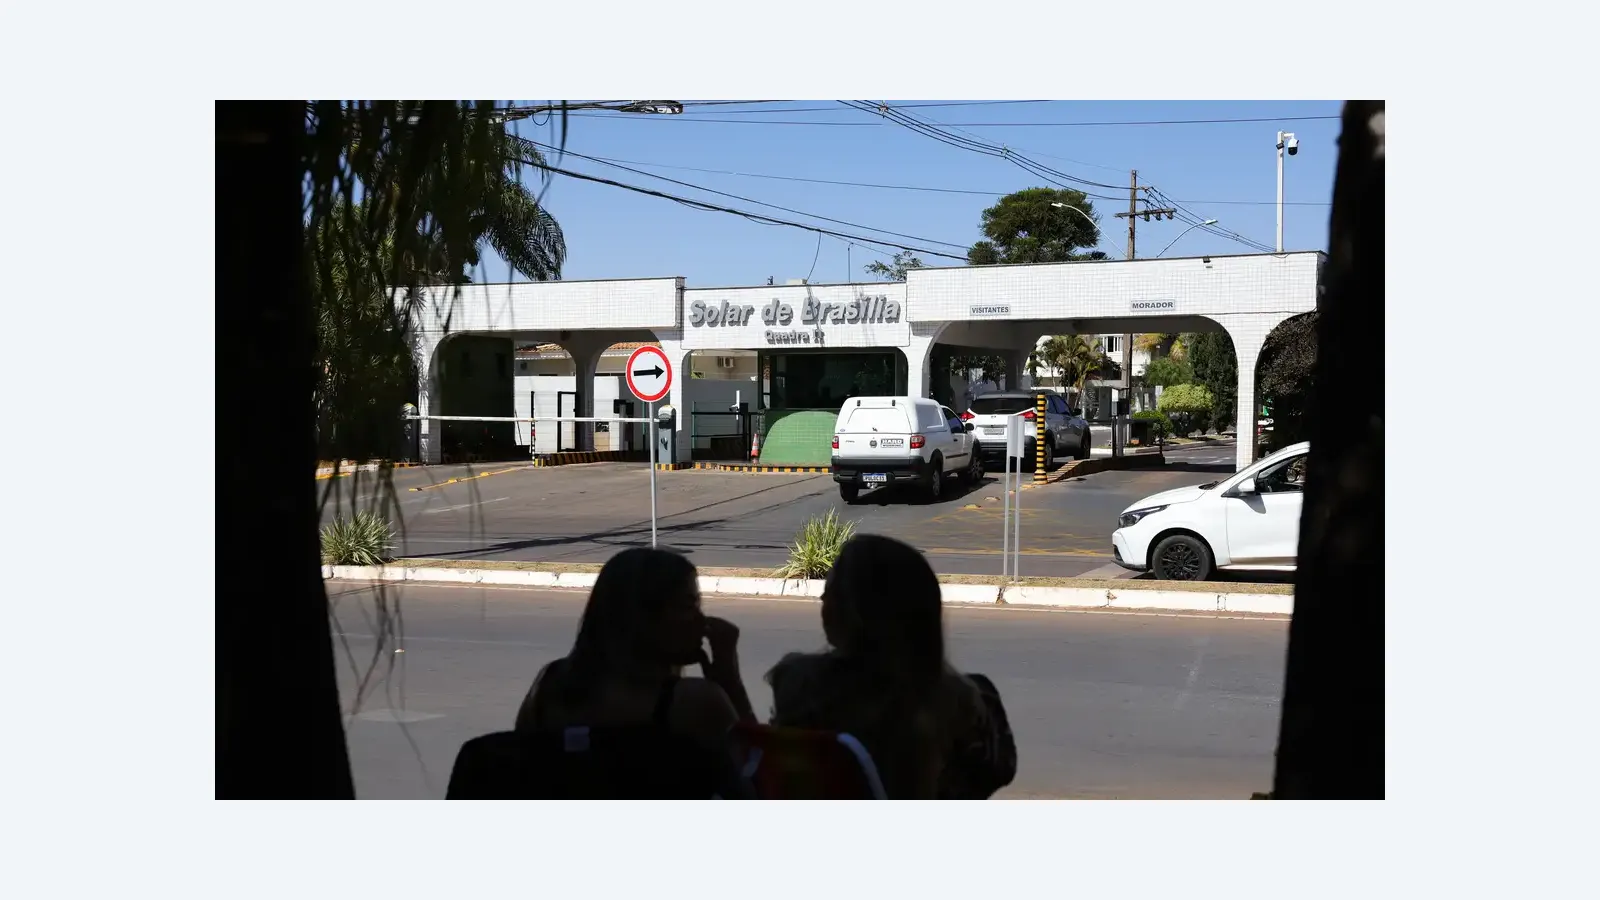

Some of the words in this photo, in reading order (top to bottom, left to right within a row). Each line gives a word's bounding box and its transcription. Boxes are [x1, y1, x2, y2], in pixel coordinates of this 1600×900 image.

[971, 306, 1009, 314] VISITANTES
[1132, 301, 1174, 309] MORADOR
[689, 299, 755, 327] Solar
[761, 298, 793, 326] de
[764, 329, 810, 344] Quadra
